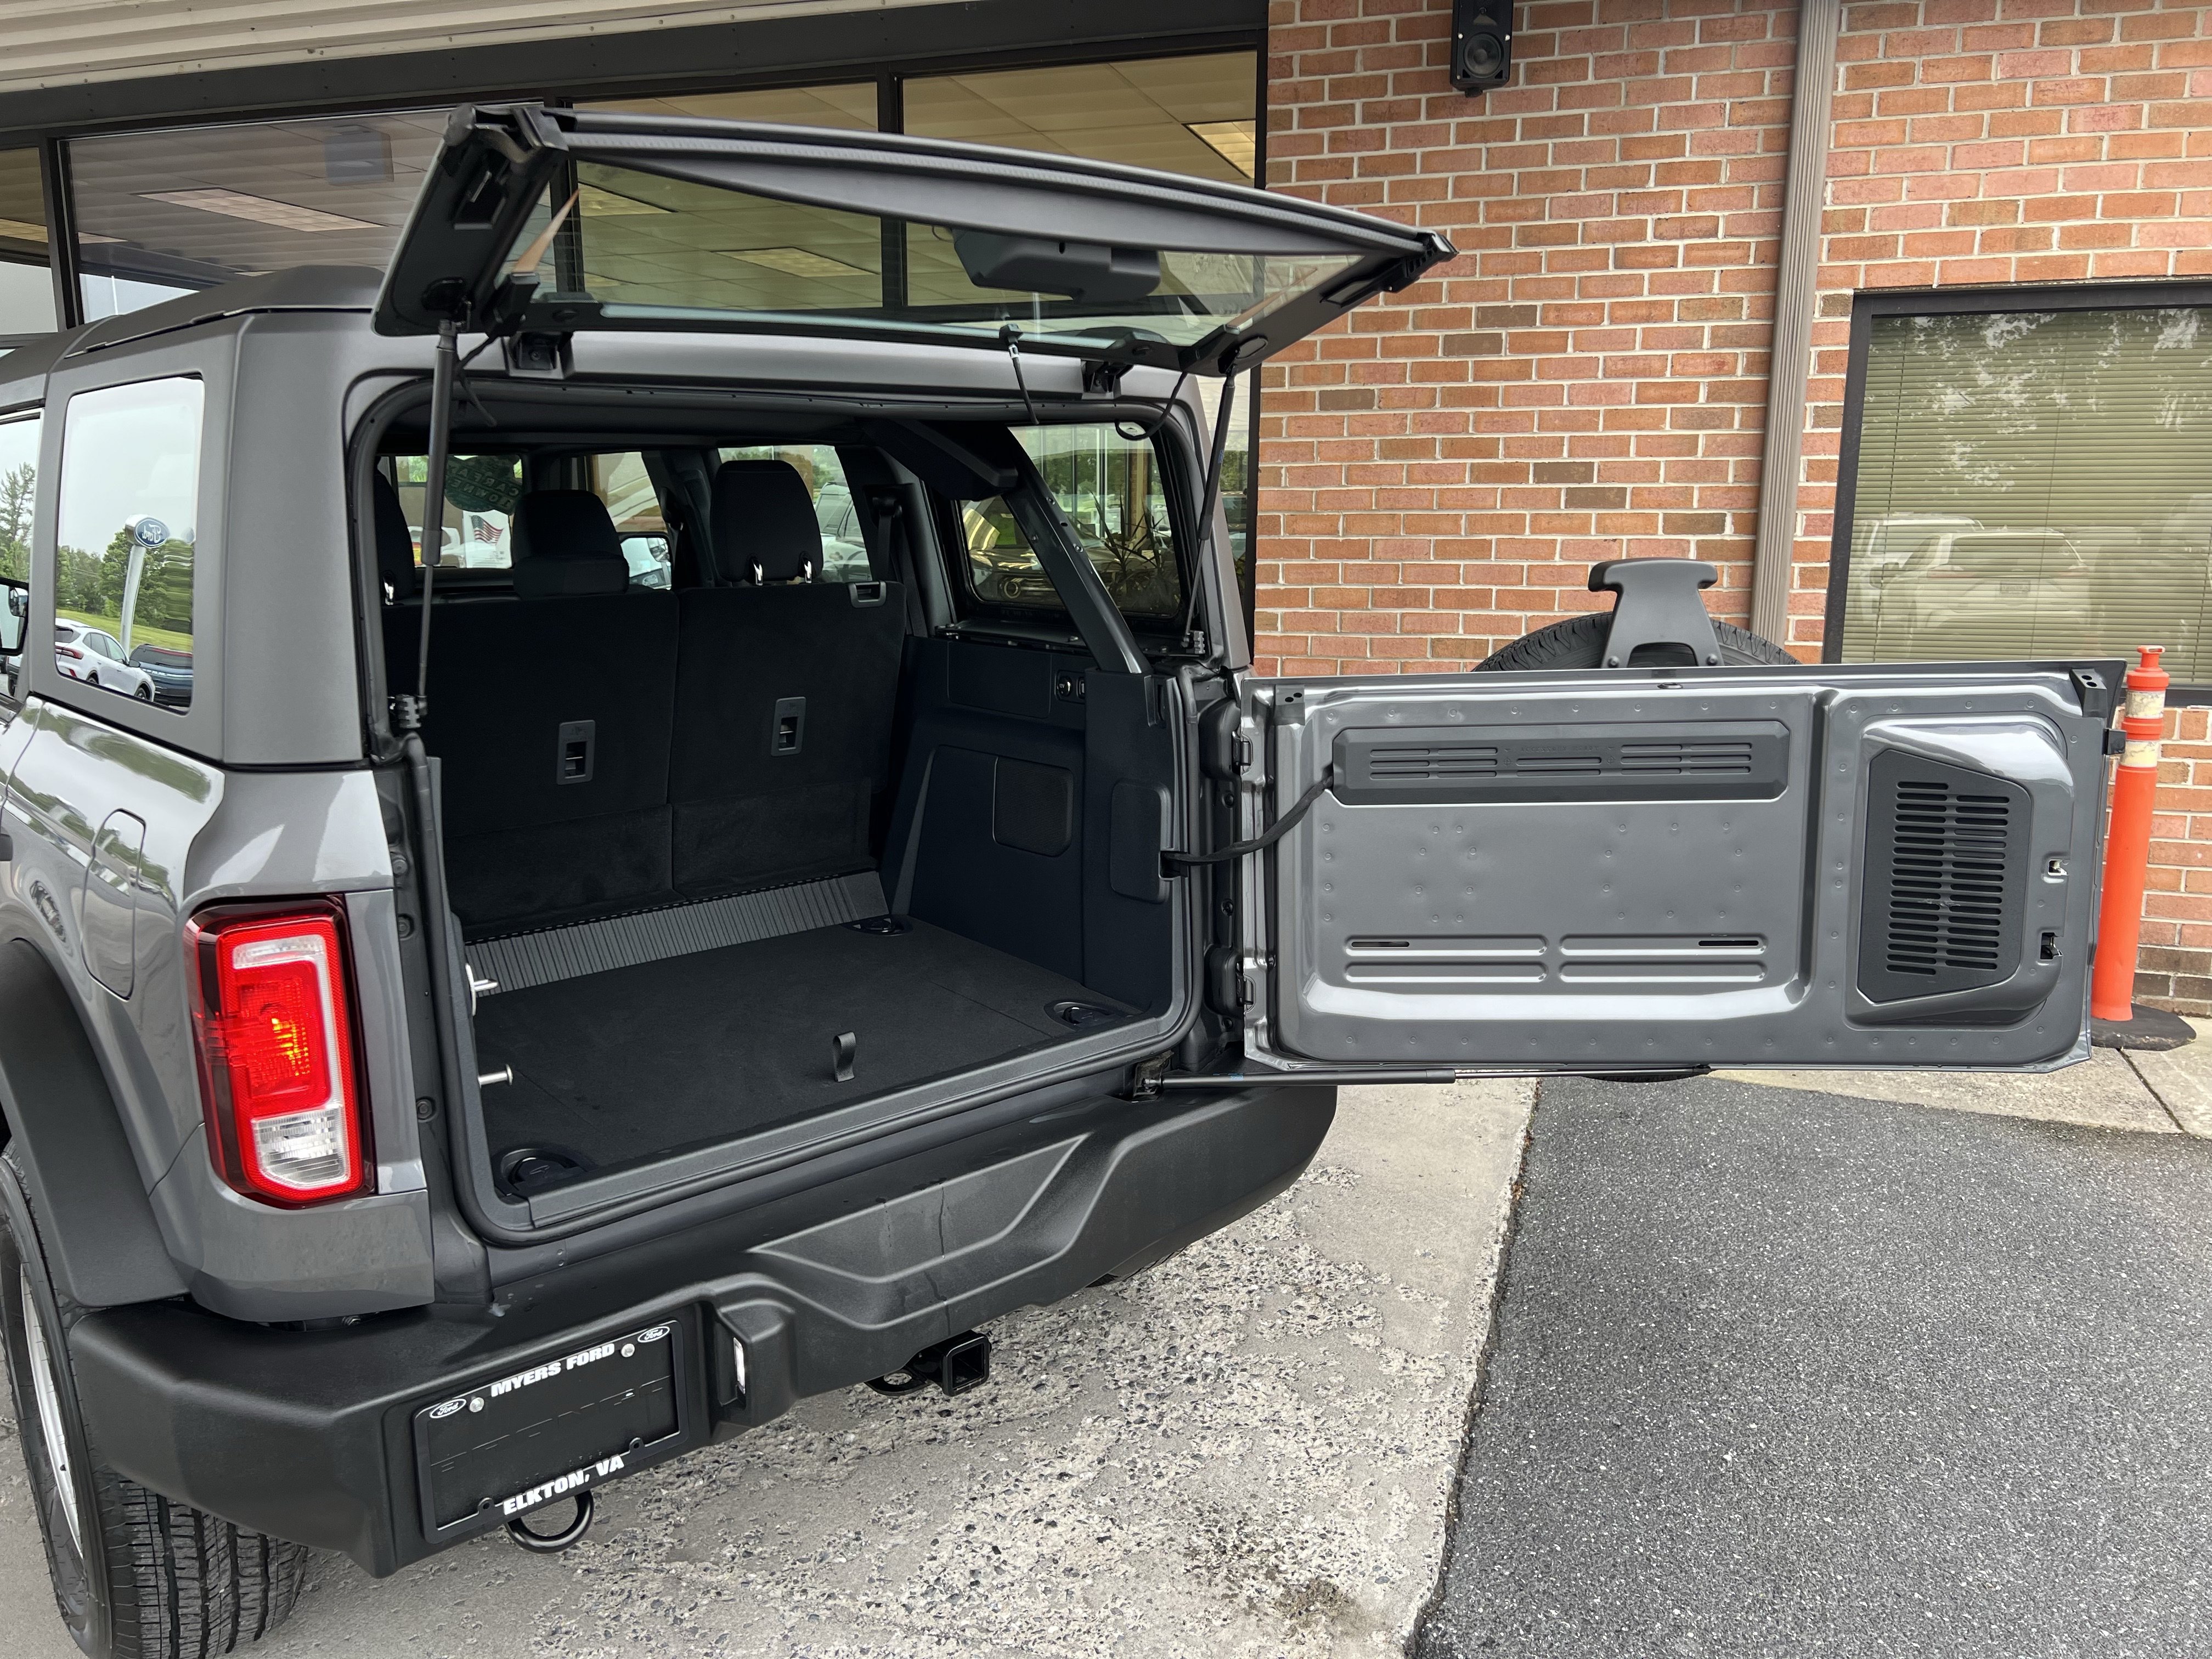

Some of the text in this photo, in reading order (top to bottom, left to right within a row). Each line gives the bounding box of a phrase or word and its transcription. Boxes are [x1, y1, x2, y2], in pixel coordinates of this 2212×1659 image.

[490, 1343, 615, 1397] MYERS FORD
[437, 1402, 459, 1417] Ford
[503, 1469, 590, 1516] ELKTON,
[595, 1454, 625, 1477] VA
